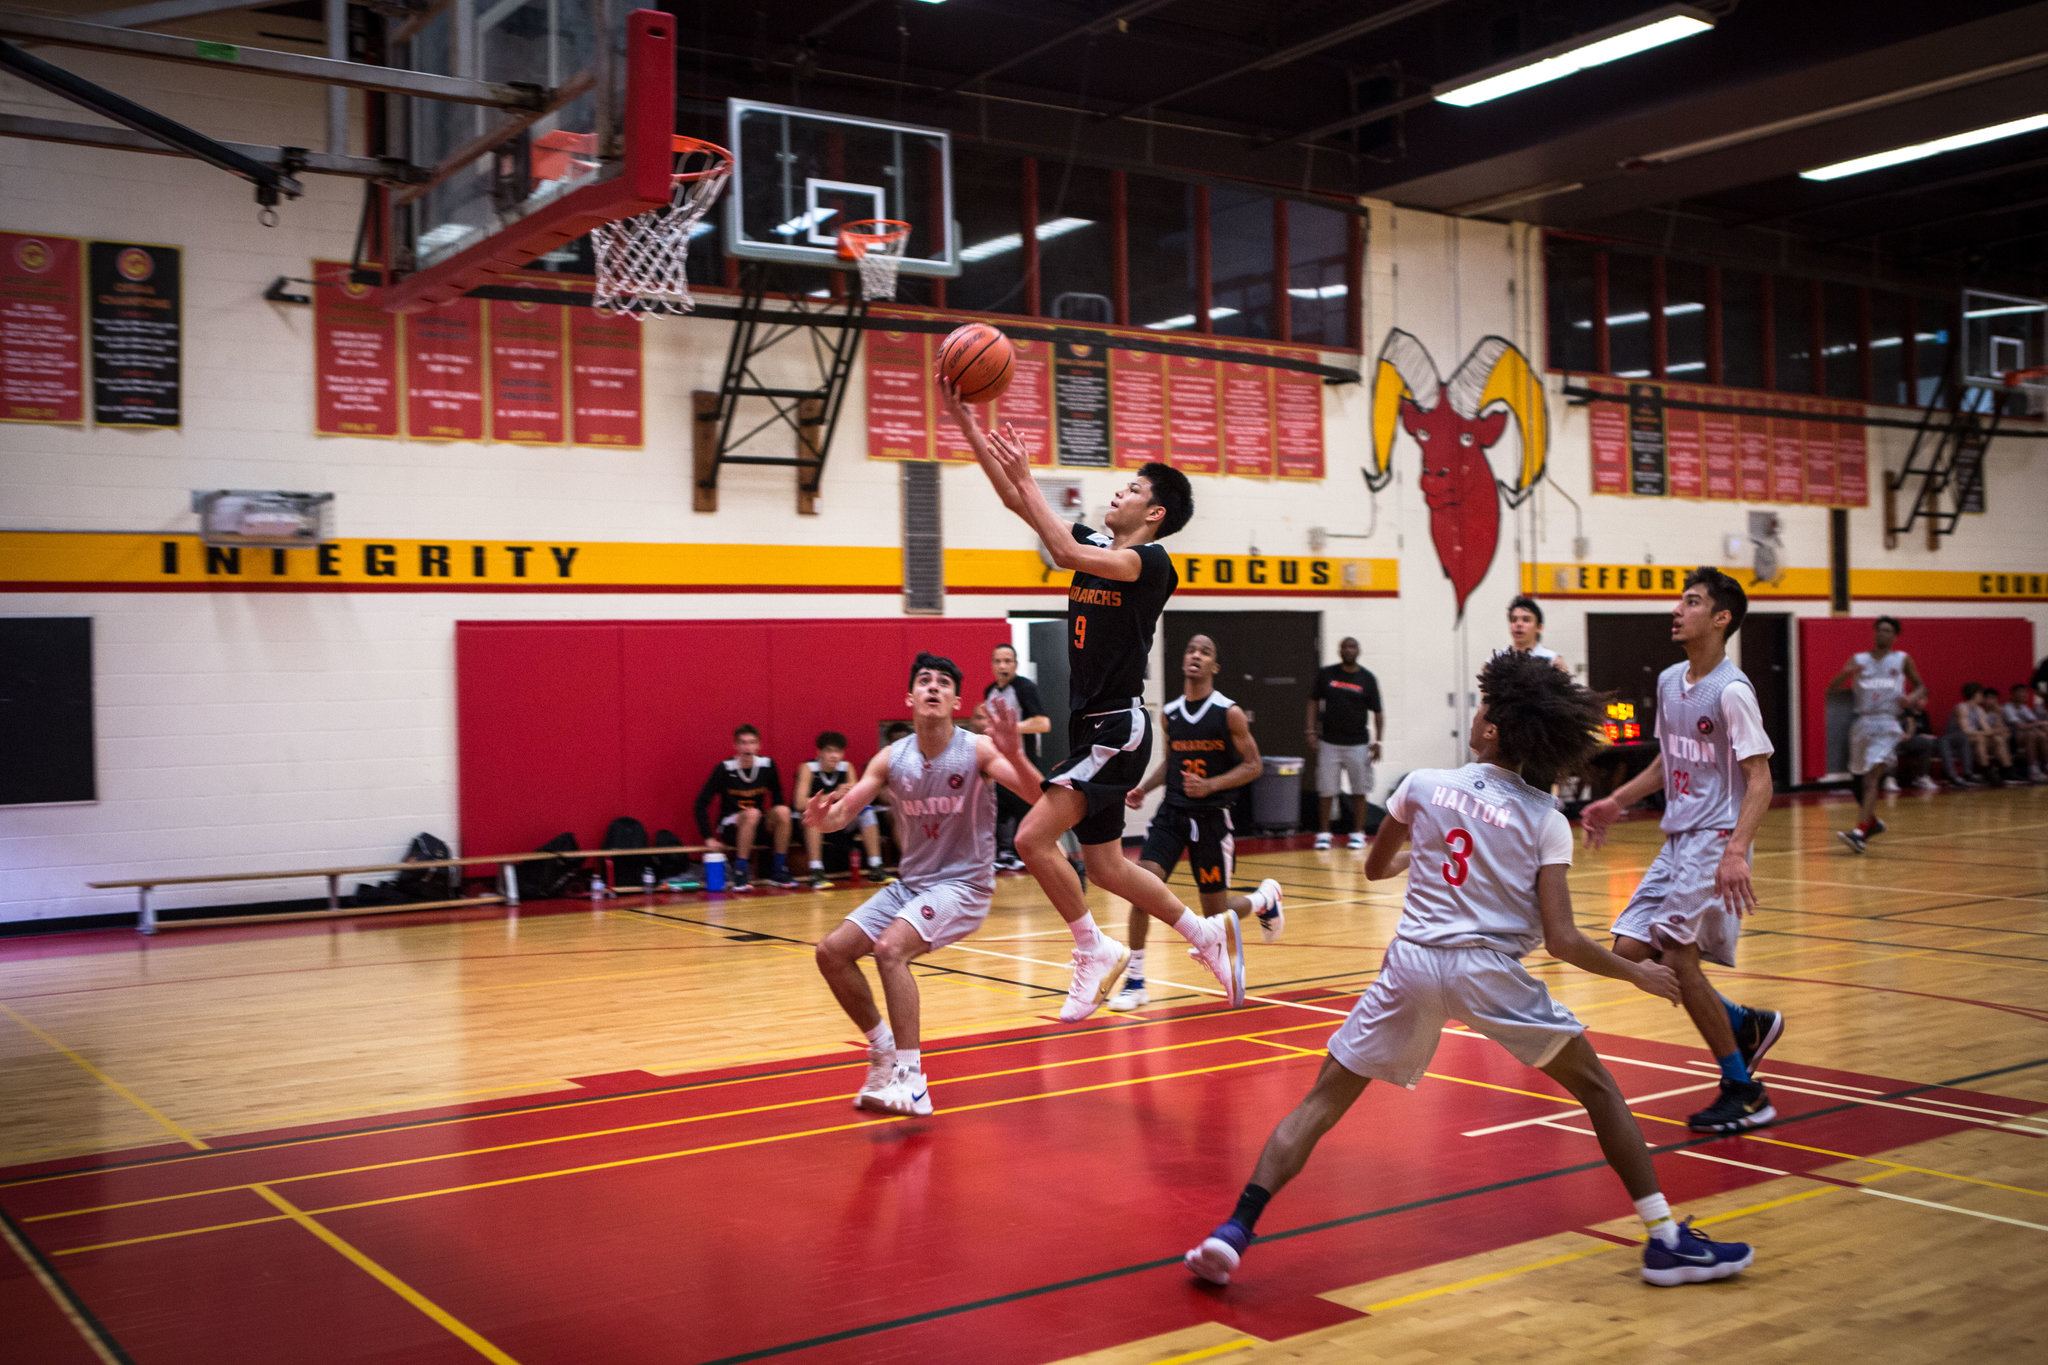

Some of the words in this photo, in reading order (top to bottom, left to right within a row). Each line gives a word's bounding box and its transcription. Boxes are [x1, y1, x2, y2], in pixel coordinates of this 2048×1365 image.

[161, 541, 580, 578] INTEGRITY
[1186, 558, 1330, 585] FOCUS
[1980, 574, 2048, 593] COUR
[1074, 615, 1087, 649] 9
[1431, 785, 1512, 829] HALTON
[1442, 827, 1474, 887] 3
